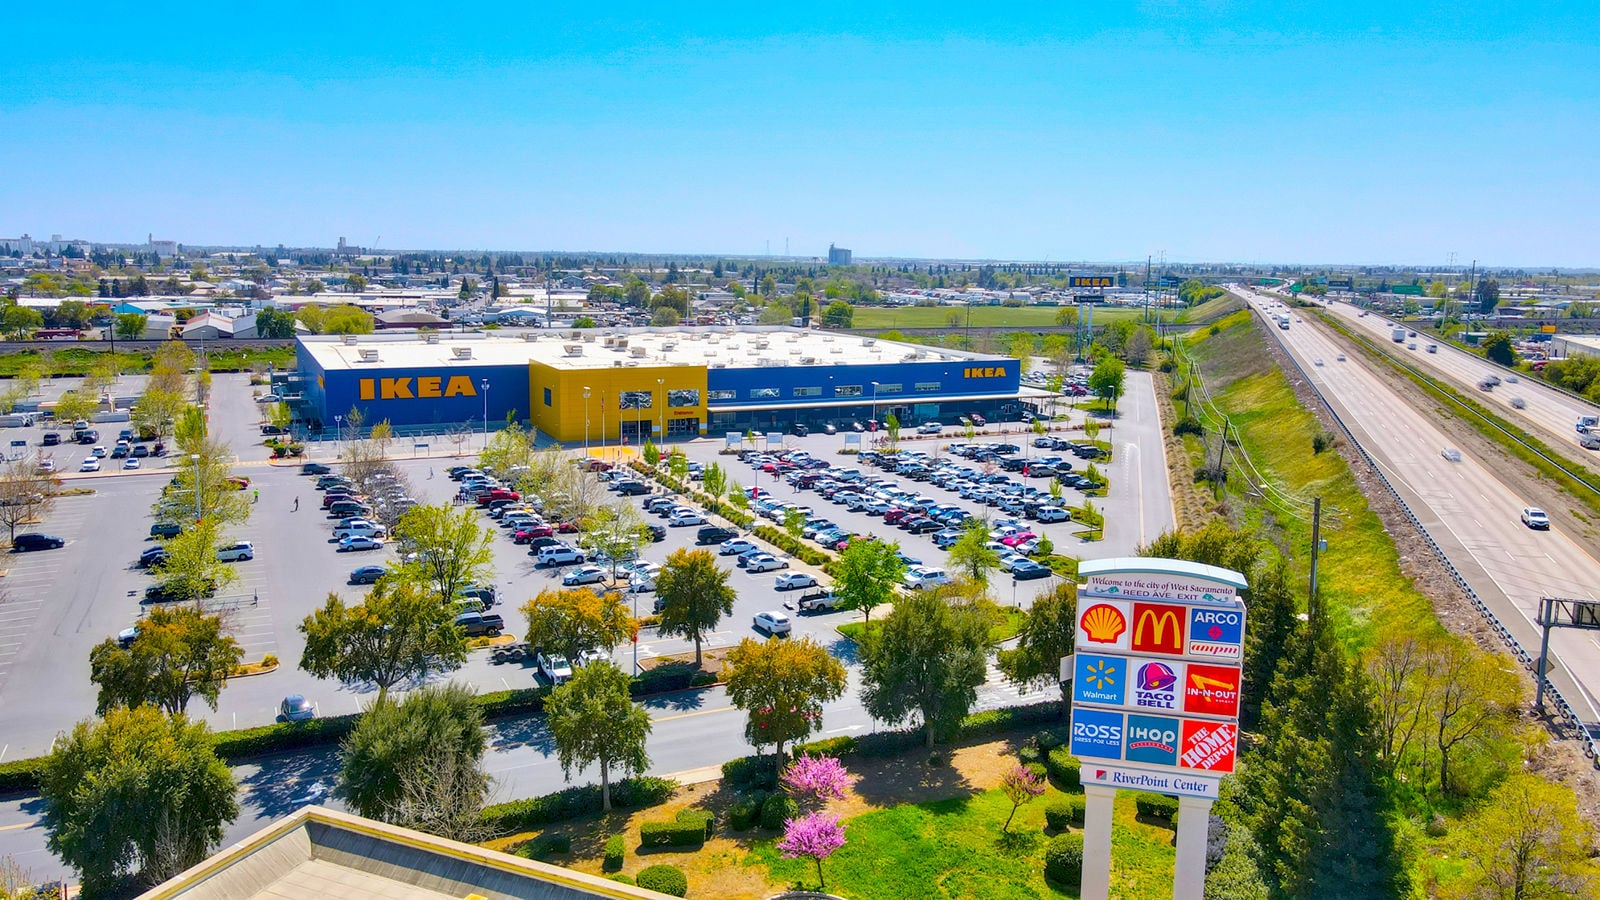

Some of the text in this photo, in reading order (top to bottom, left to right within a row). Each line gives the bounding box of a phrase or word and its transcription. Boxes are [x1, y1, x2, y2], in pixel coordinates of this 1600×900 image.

[1074, 278, 1111, 286] IKEA
[963, 367, 1007, 378] IKEA
[359, 375, 478, 400] IKEA
[1092, 577, 1123, 587] Welcome
[1133, 580, 1145, 588] the
[1146, 581, 1161, 590] city
[1161, 581, 1171, 592] of
[1171, 583, 1188, 591] West
[1190, 584, 1233, 595] Sacramento
[1123, 589, 1199, 601] REED AVE EXIT
[1194, 611, 1239, 626] ARCO
[1191, 644, 1238, 655] ampm
[1082, 690, 1117, 701] Walmart
[1135, 690, 1175, 701] TACO
[1187, 687, 1237, 699] IN-N-OUT
[1137, 699, 1175, 709] BELL
[1073, 722, 1121, 740] ROSS
[1187, 726, 1210, 745] THE
[1181, 724, 1236, 768] HOME
[1201, 741, 1235, 770] DEPOT
[1113, 771, 1209, 792] RiverPoint Center
